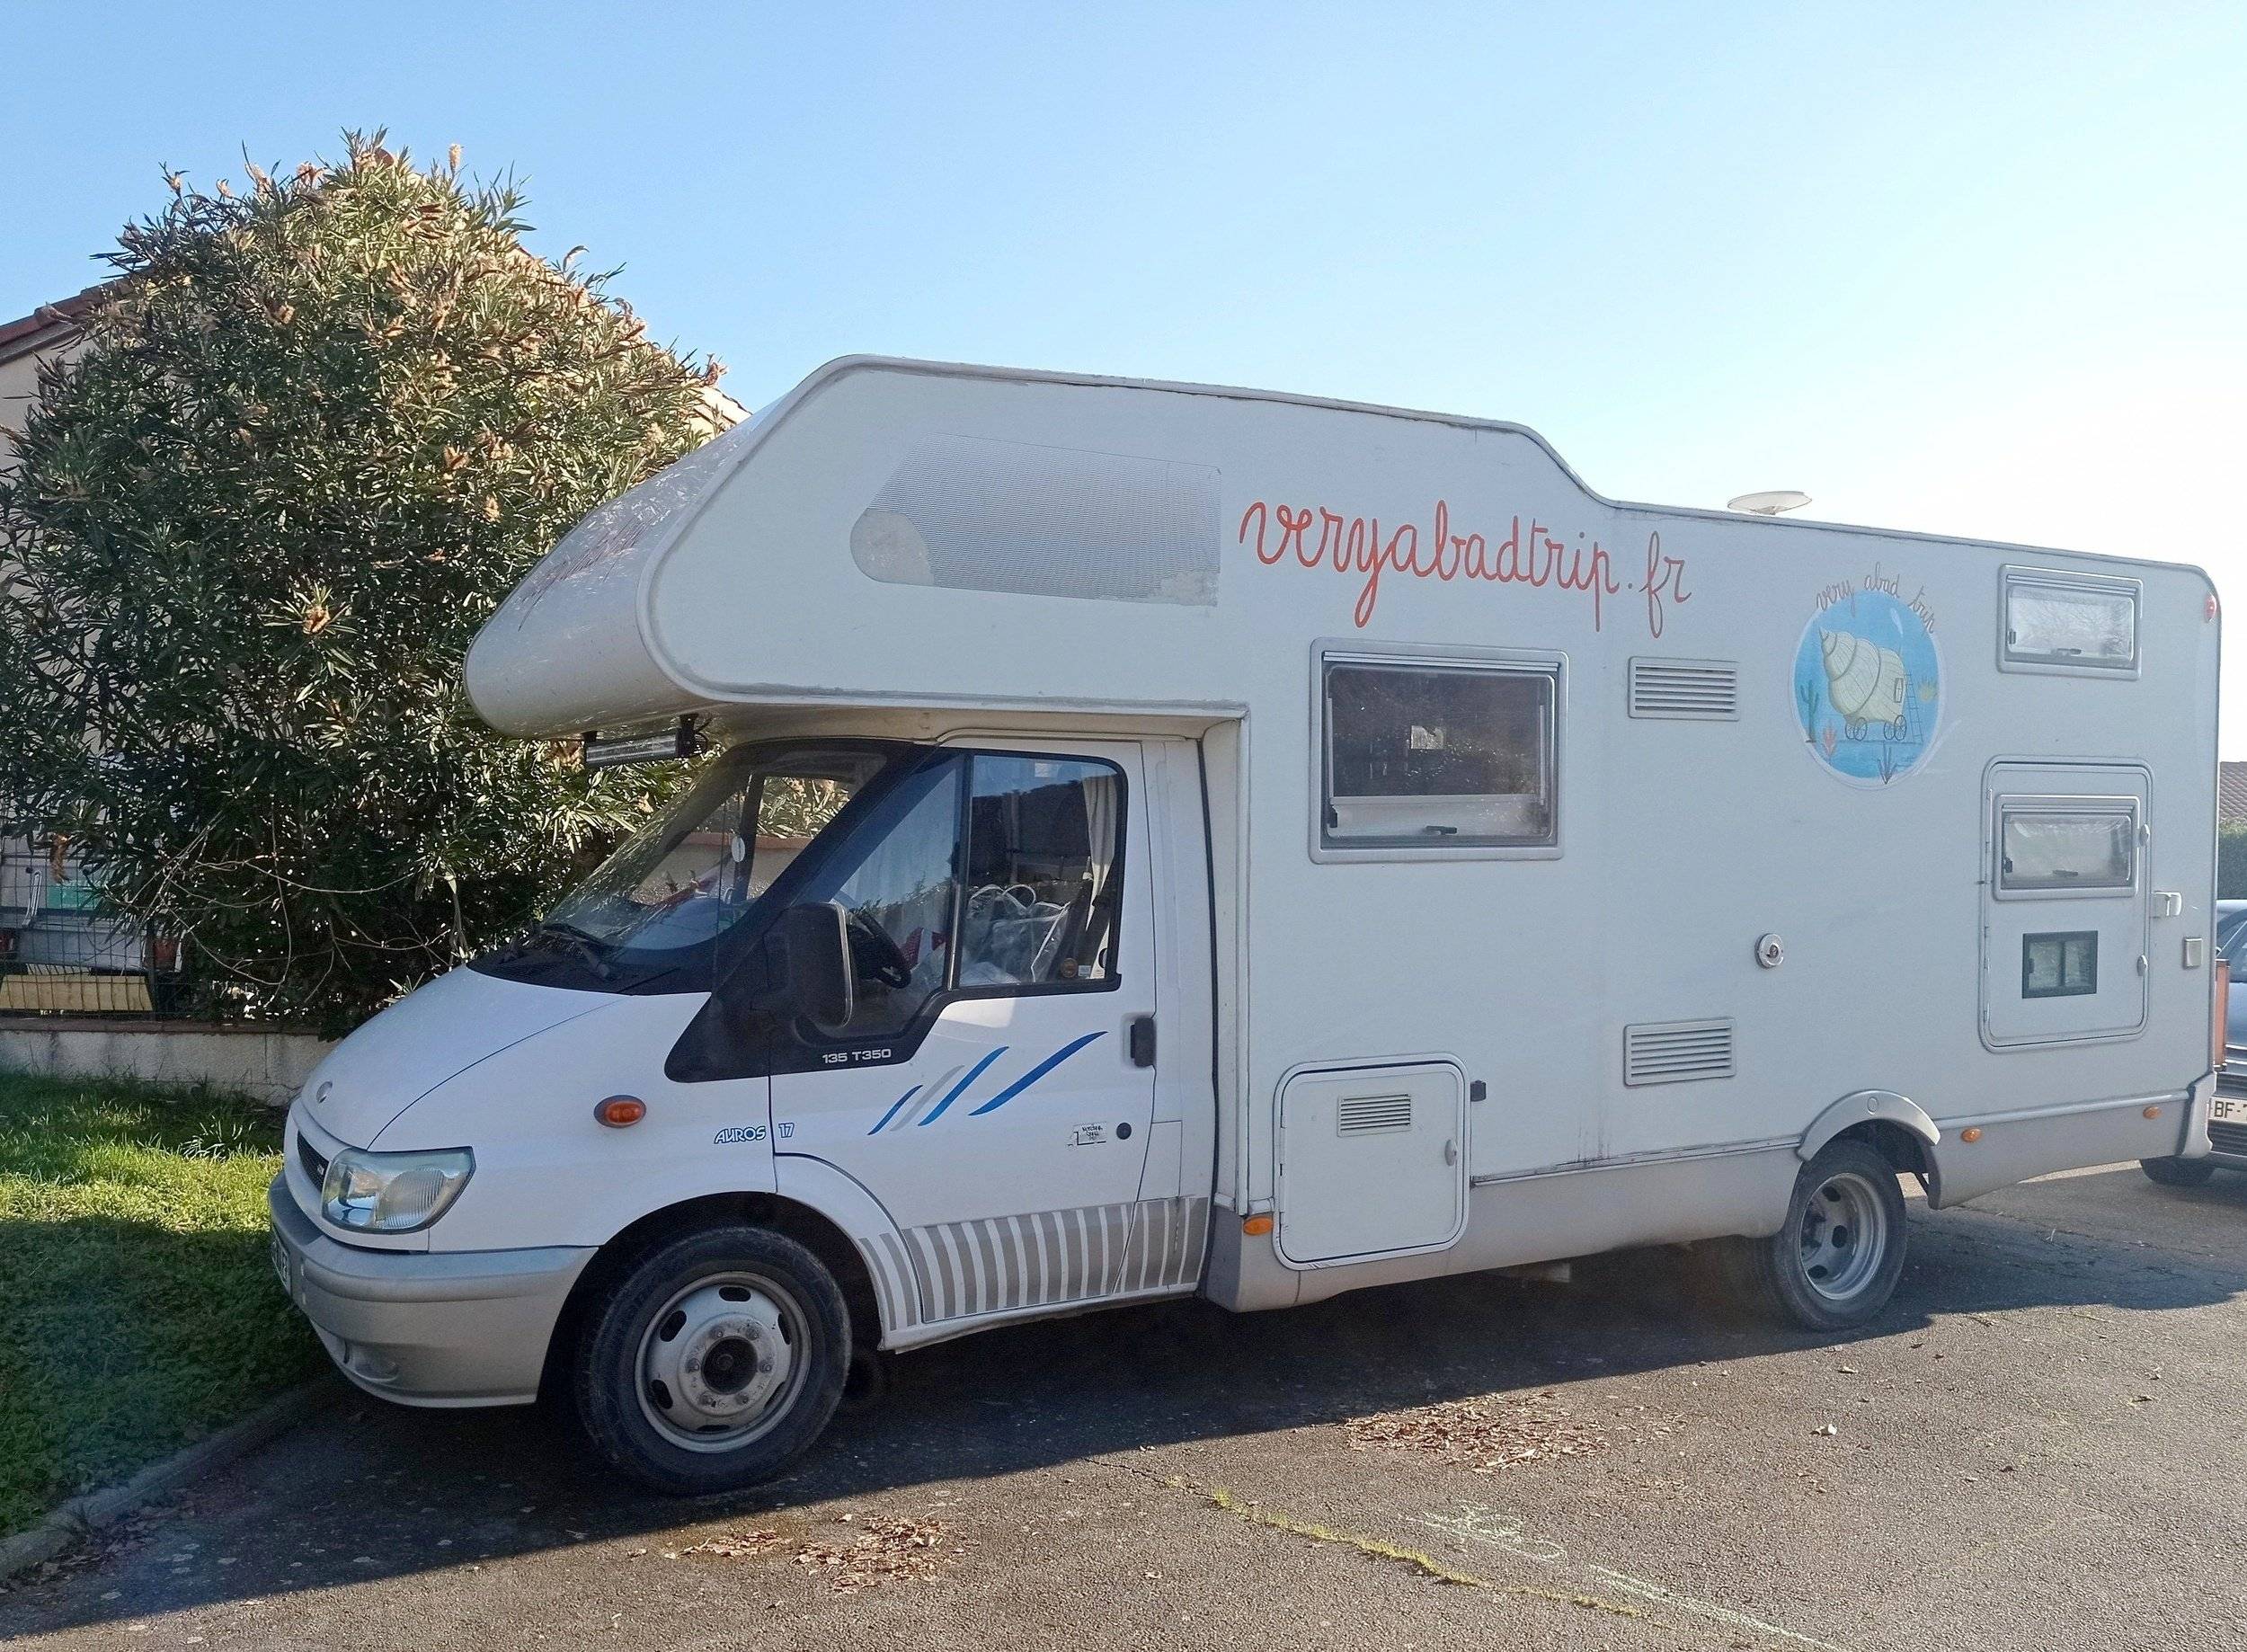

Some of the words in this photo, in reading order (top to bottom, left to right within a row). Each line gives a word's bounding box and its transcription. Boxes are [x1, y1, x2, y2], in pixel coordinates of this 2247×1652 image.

[822, 1052, 848, 1063] 135
[852, 1049, 892, 1061] T350
[714, 1125, 766, 1144] AUROS
[778, 1123, 795, 1138] 17
